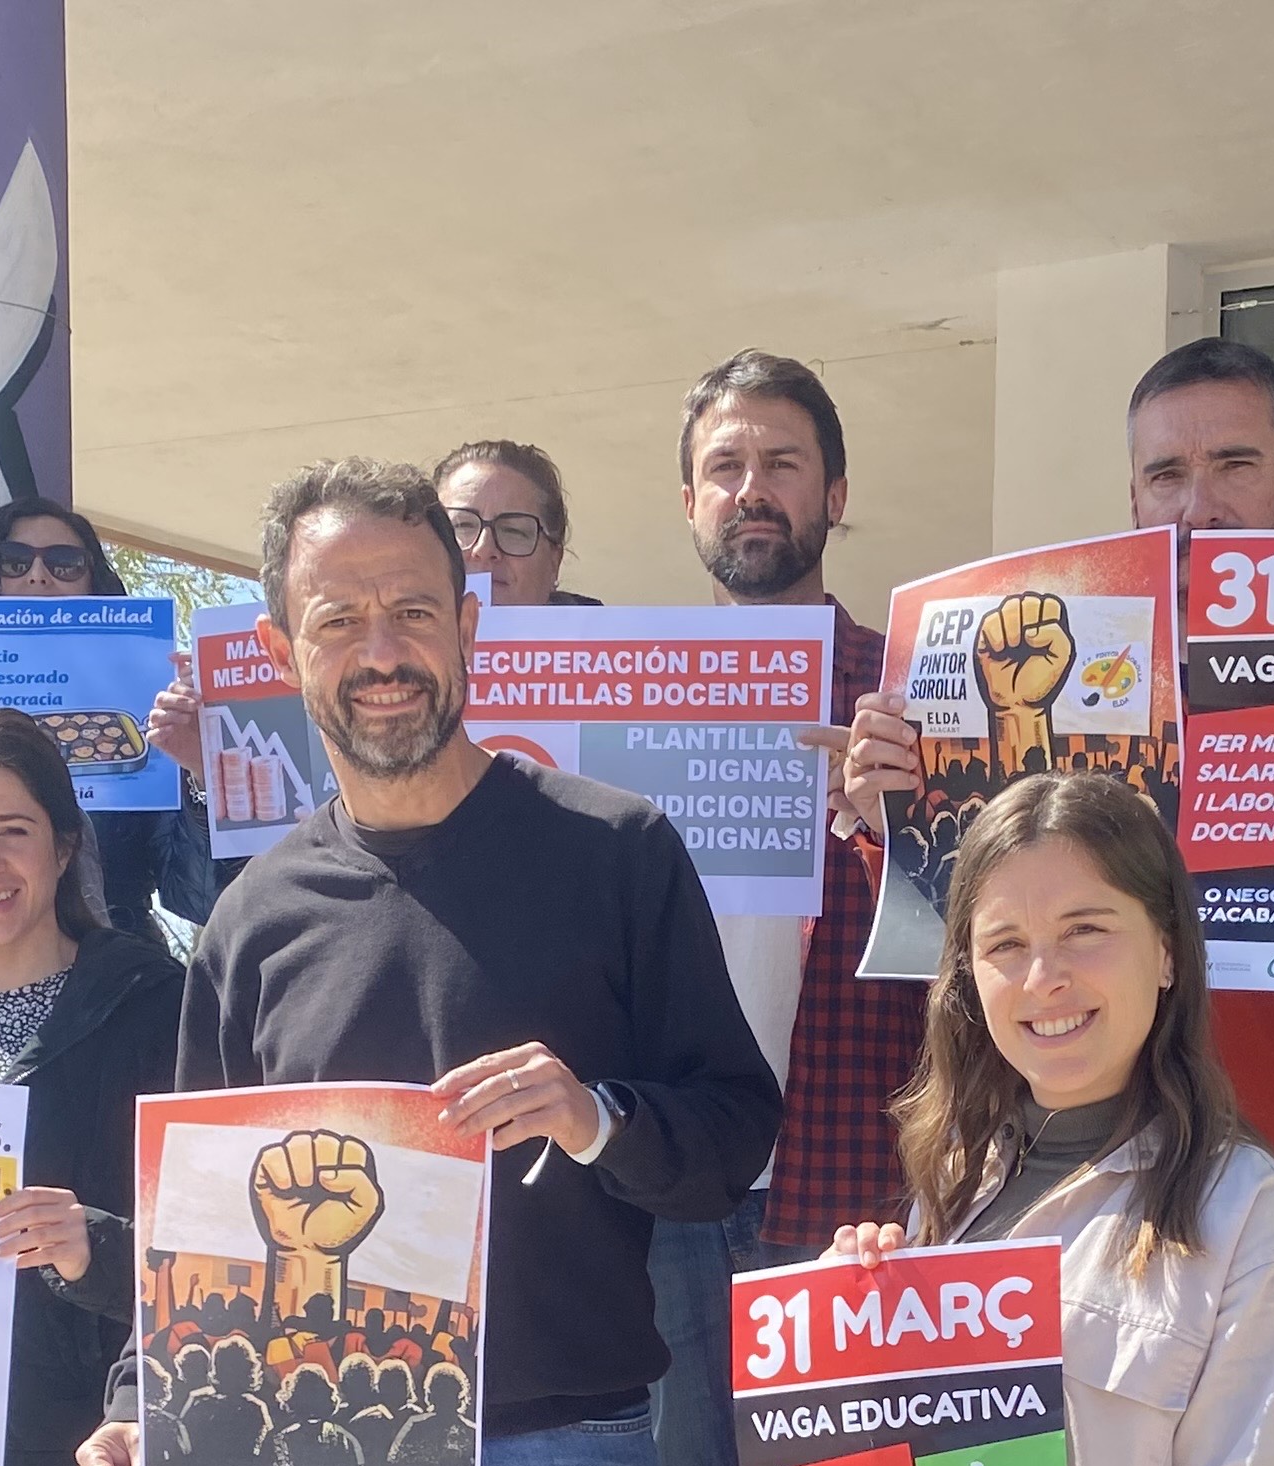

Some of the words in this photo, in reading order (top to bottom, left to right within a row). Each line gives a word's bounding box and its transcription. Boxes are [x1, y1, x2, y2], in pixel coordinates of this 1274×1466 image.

[49, 608, 72, 624] de
[79, 605, 154, 624] calidad
[926, 608, 974, 648] CEP
[467, 646, 688, 675] ECUPERACIÓN
[699, 650, 739, 674] DE
[750, 650, 809, 674] LAS
[919, 652, 968, 676] PINTOR
[469, 682, 633, 706] LANTILLAS
[643, 682, 810, 706] DOCENTES
[910, 678, 967, 701] SOROLLA
[927, 712, 961, 725] ELDA
[1198, 733, 1247, 754] PER
[688, 759, 814, 788] DIGNAS,
[1193, 793, 1203, 813] I
[686, 826, 811, 851] DIGNAS!
[1204, 888, 1222, 903] O
[746, 1288, 811, 1379] 31
[832, 1276, 1034, 1351] MARÇ
[751, 1405, 836, 1442] VAGA
[841, 1384, 1047, 1433] EDUCATIVA
